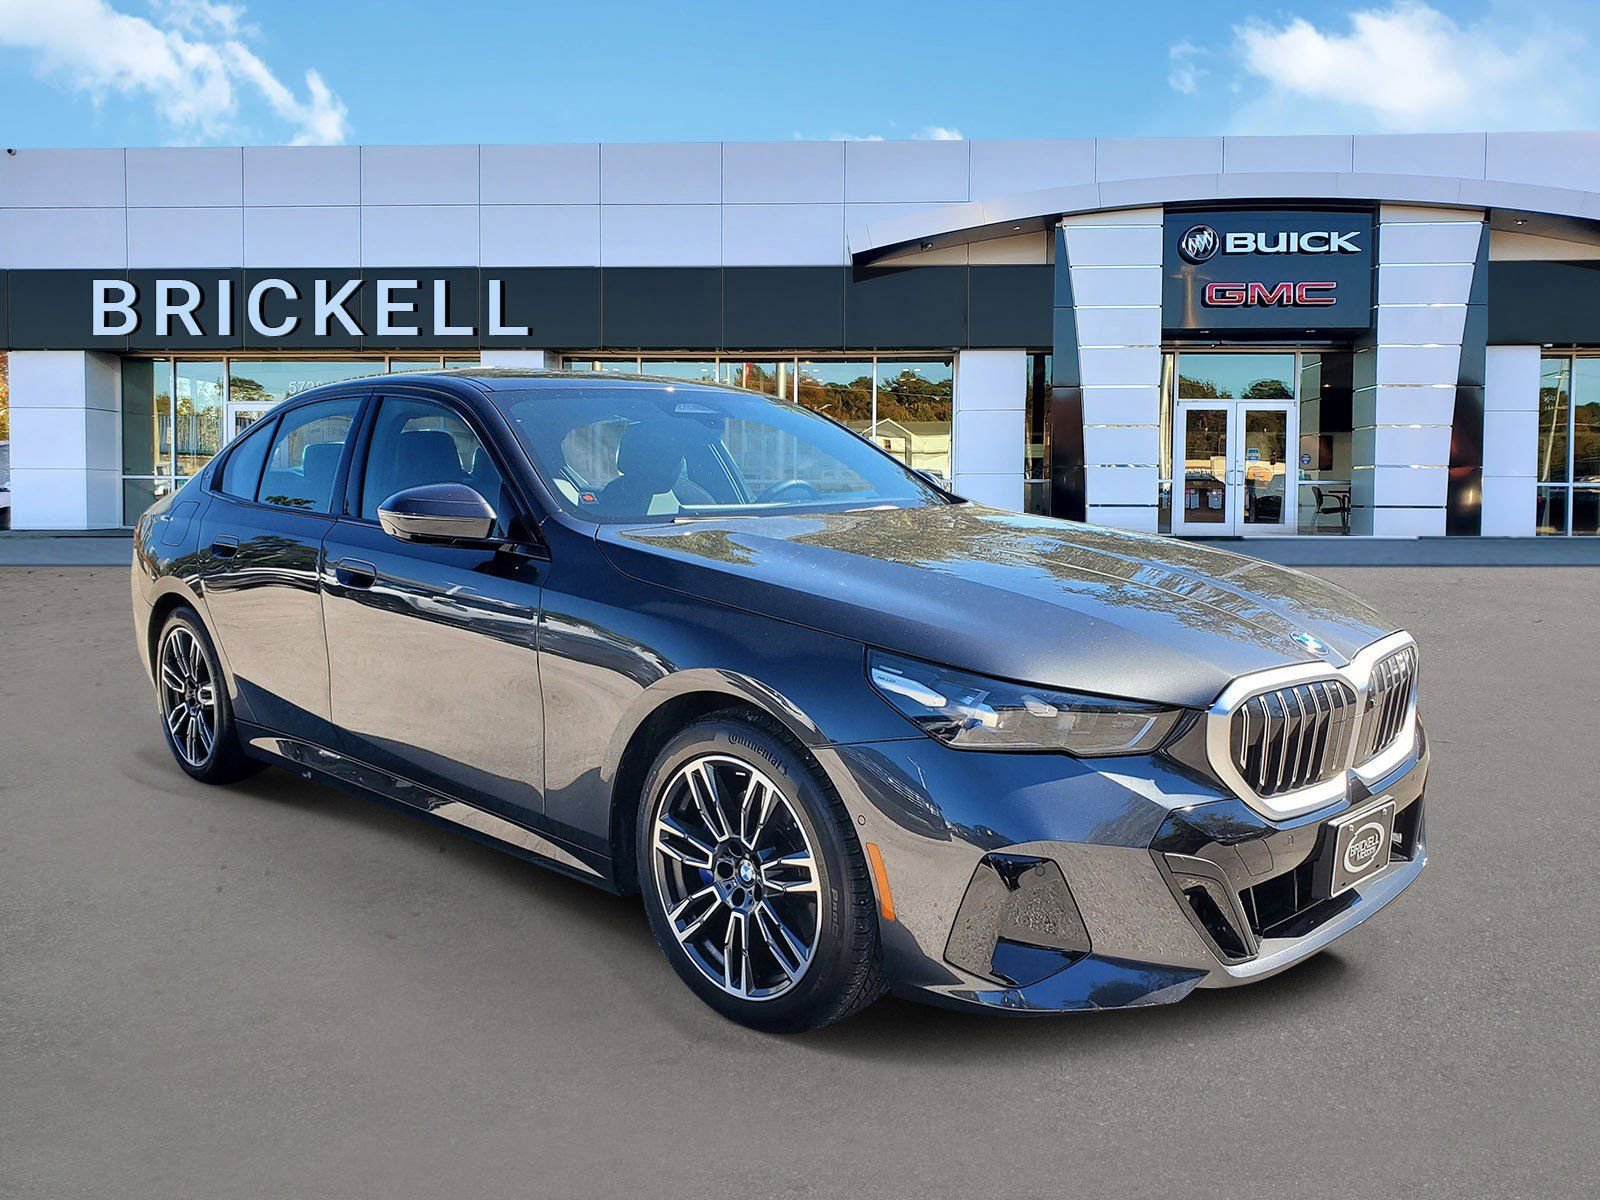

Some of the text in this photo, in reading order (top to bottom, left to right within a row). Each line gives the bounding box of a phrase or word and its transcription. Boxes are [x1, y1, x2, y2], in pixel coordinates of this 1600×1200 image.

[1225, 231, 1362, 253] BUICK
[1205, 281, 1337, 305] GMC
[91, 278, 531, 337] BRICKELL
